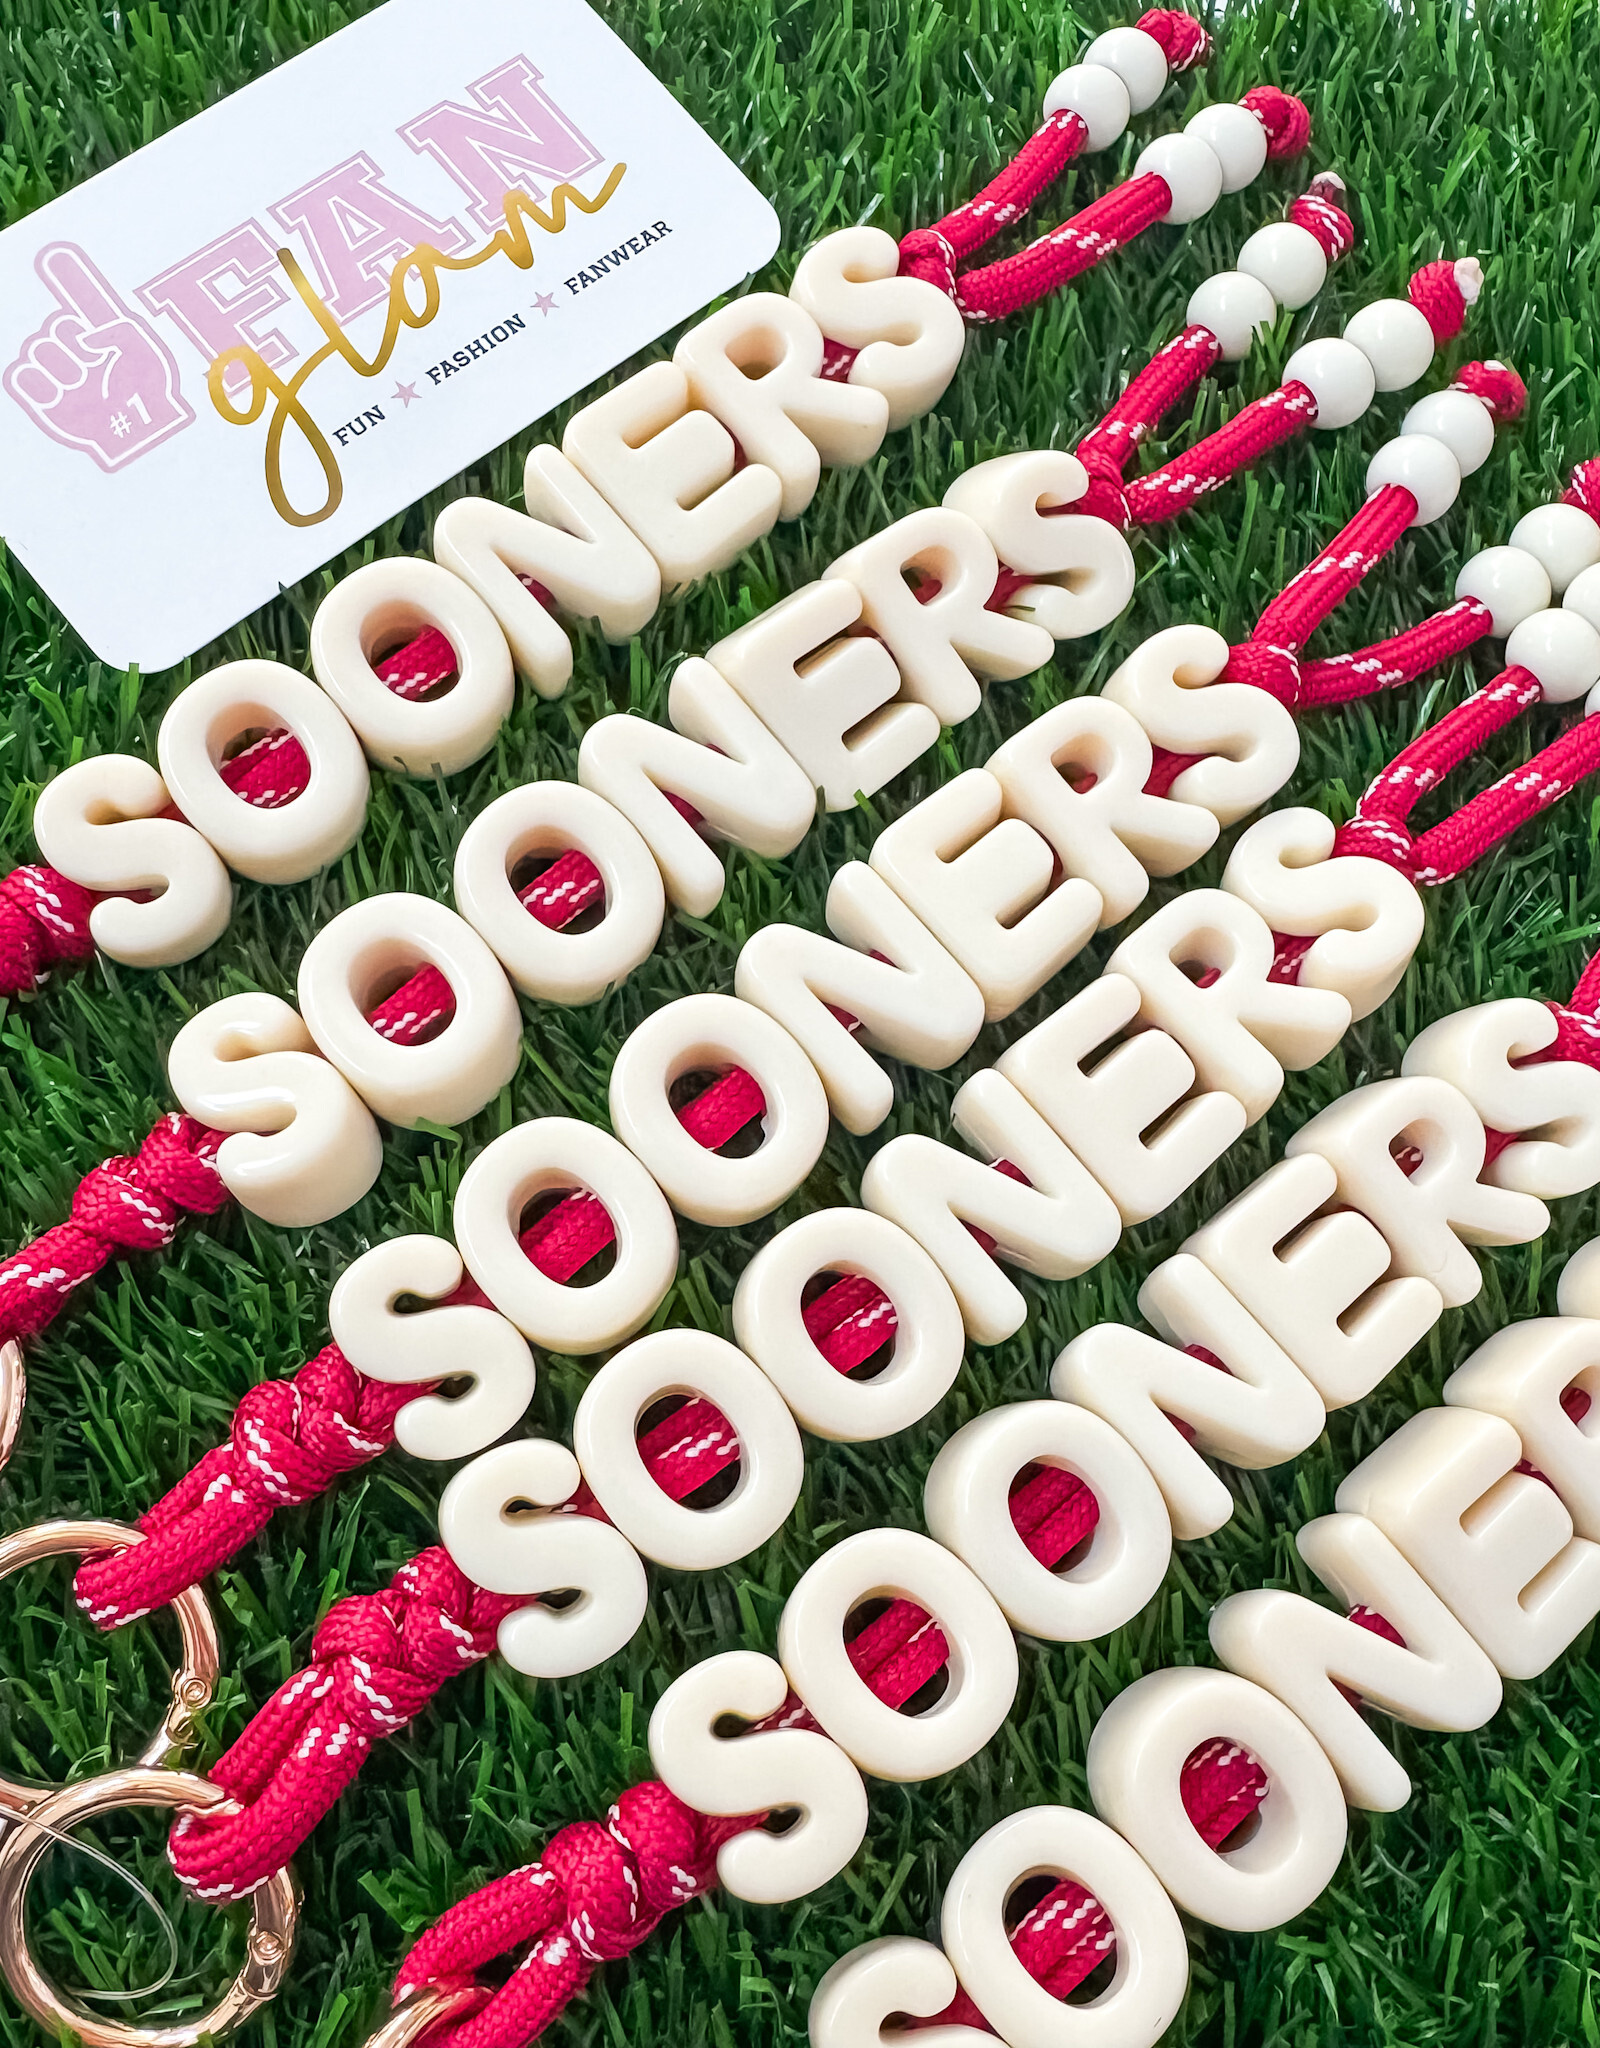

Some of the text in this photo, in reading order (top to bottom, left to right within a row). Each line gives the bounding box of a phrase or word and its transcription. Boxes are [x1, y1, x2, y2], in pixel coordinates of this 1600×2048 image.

[110, 392, 153, 438] #1
[133, 52, 606, 397] FAN
[207, 162, 627, 527] glam
[332, 220, 674, 447] FUN FASHION FANWEAR
[34, 226, 966, 968] SOONERS
[169, 450, 1135, 1227] SOONERS
[330, 624, 1301, 1460] SOONERS
[439, 806, 1424, 1679] SOONERS
[649, 997, 1600, 1904] SOONERS
